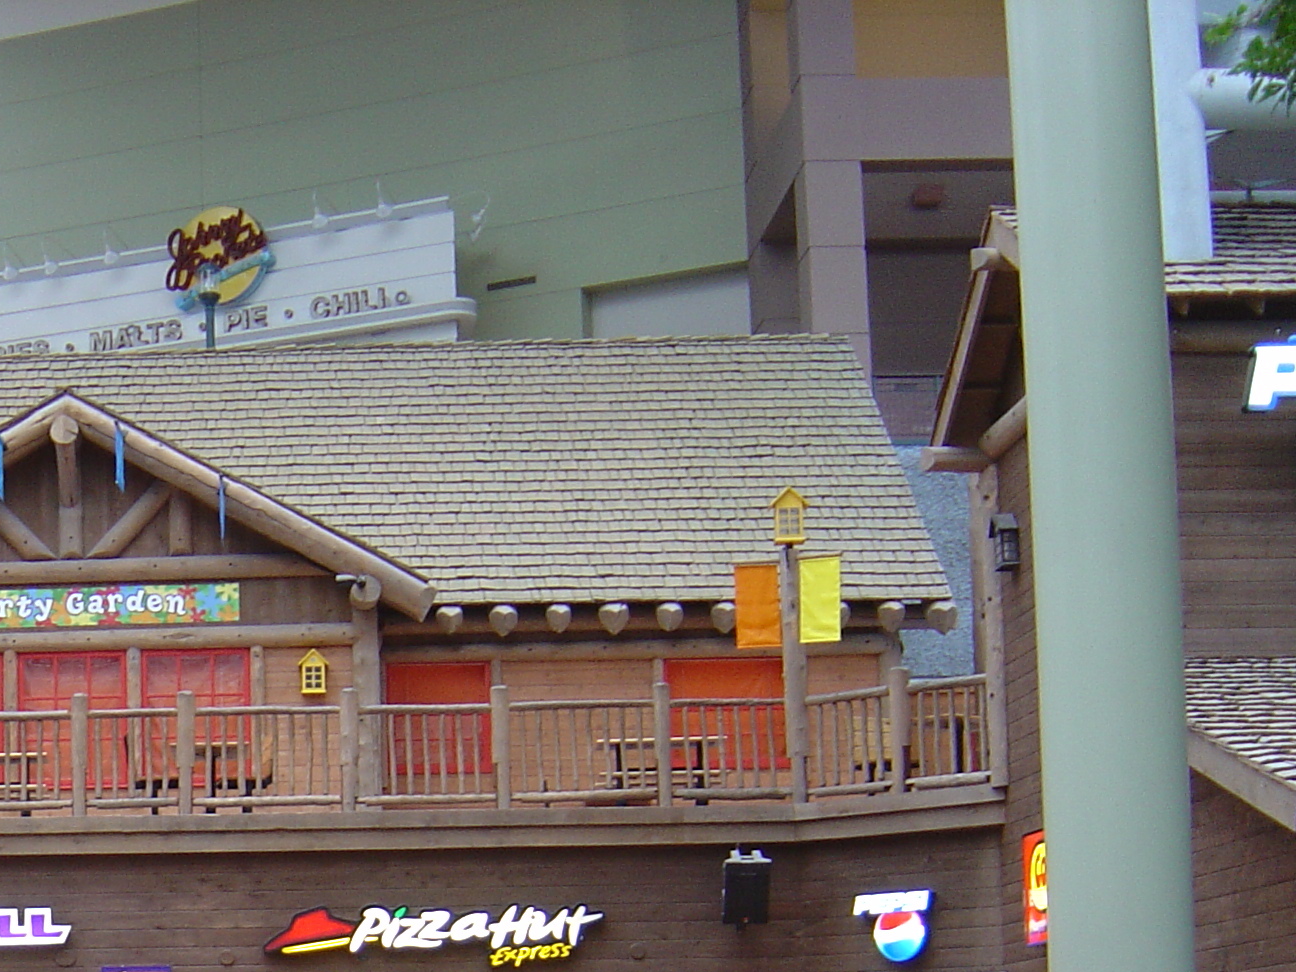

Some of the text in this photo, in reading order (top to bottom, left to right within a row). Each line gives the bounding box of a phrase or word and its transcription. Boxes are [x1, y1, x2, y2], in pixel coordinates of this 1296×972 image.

[89, 319, 184, 352] MALTS
[223, 304, 268, 333] PIE
[66, 589, 187, 617] Garden
[349, 903, 604, 952] Pizza Hut
[489, 942, 573, 967] Express
